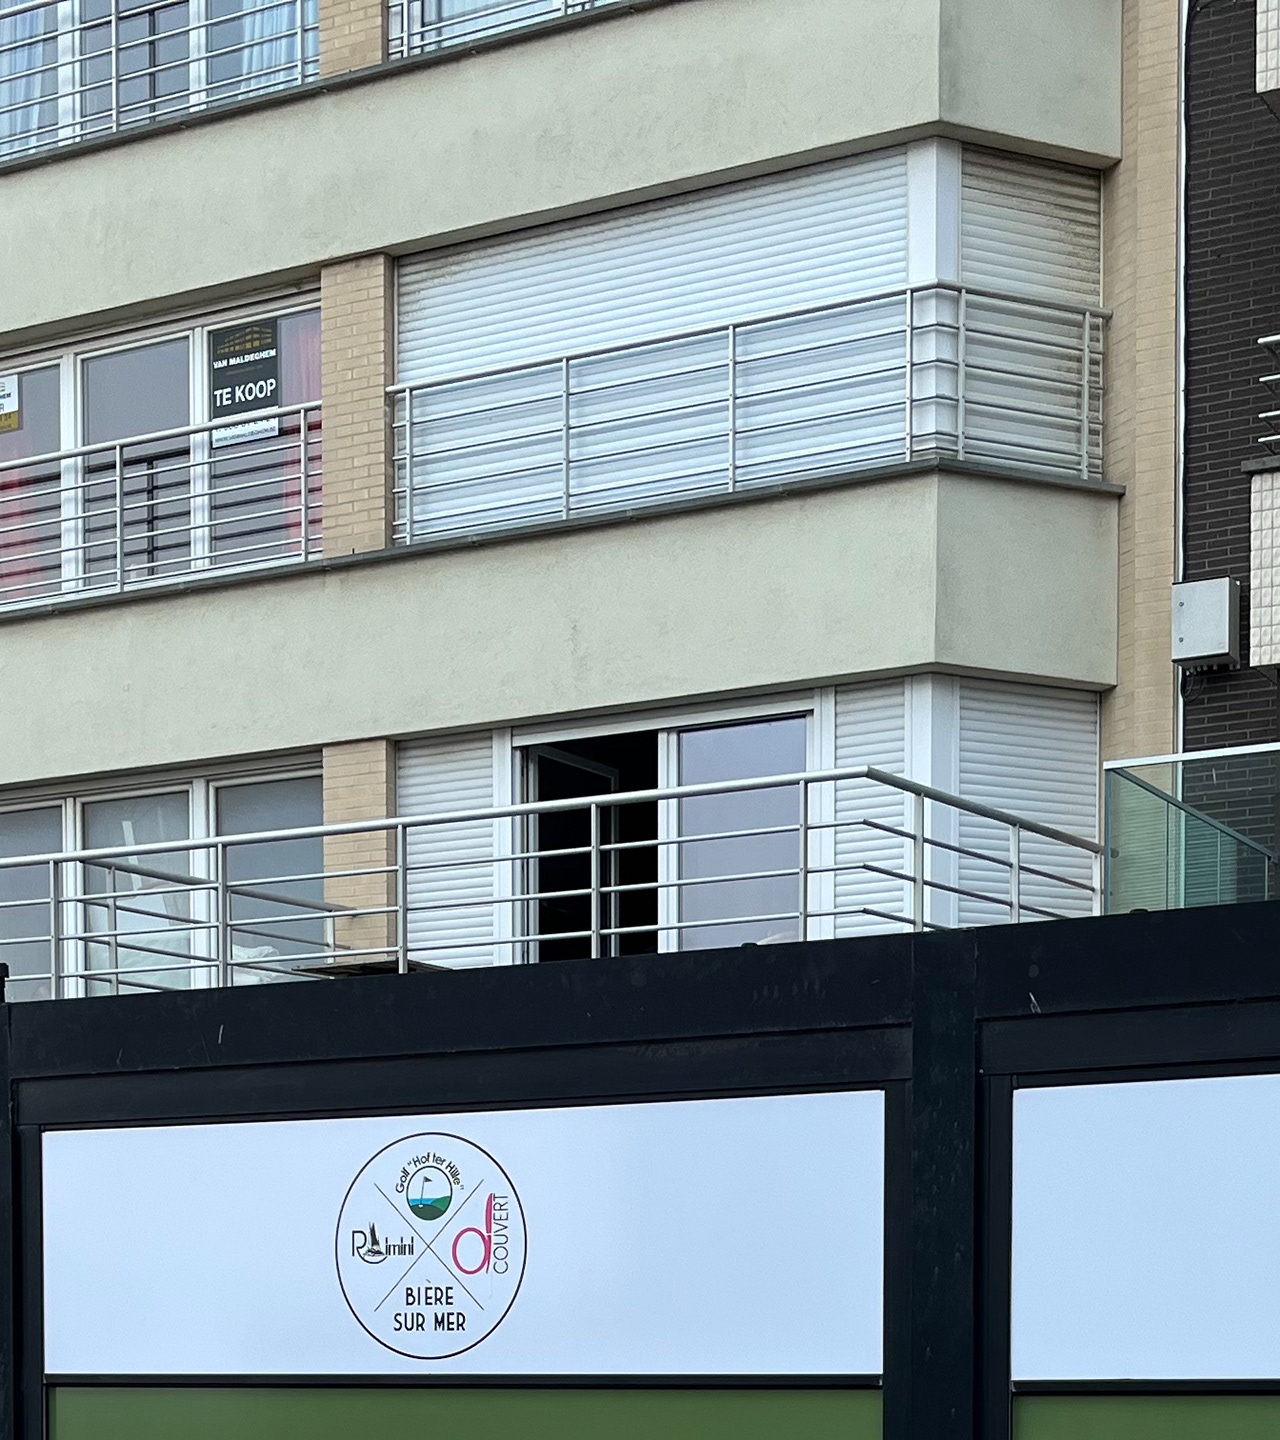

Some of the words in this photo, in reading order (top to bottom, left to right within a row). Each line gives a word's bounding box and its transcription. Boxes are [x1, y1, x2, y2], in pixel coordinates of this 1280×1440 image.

[214, 387, 232, 407] TE
[235, 378, 276, 403] KOOP
[352, 1229, 414, 1264] Rimini
[492, 1192, 509, 1275] COUVERT
[393, 1312, 426, 1332] SUR
[434, 1312, 466, 1332] MER
